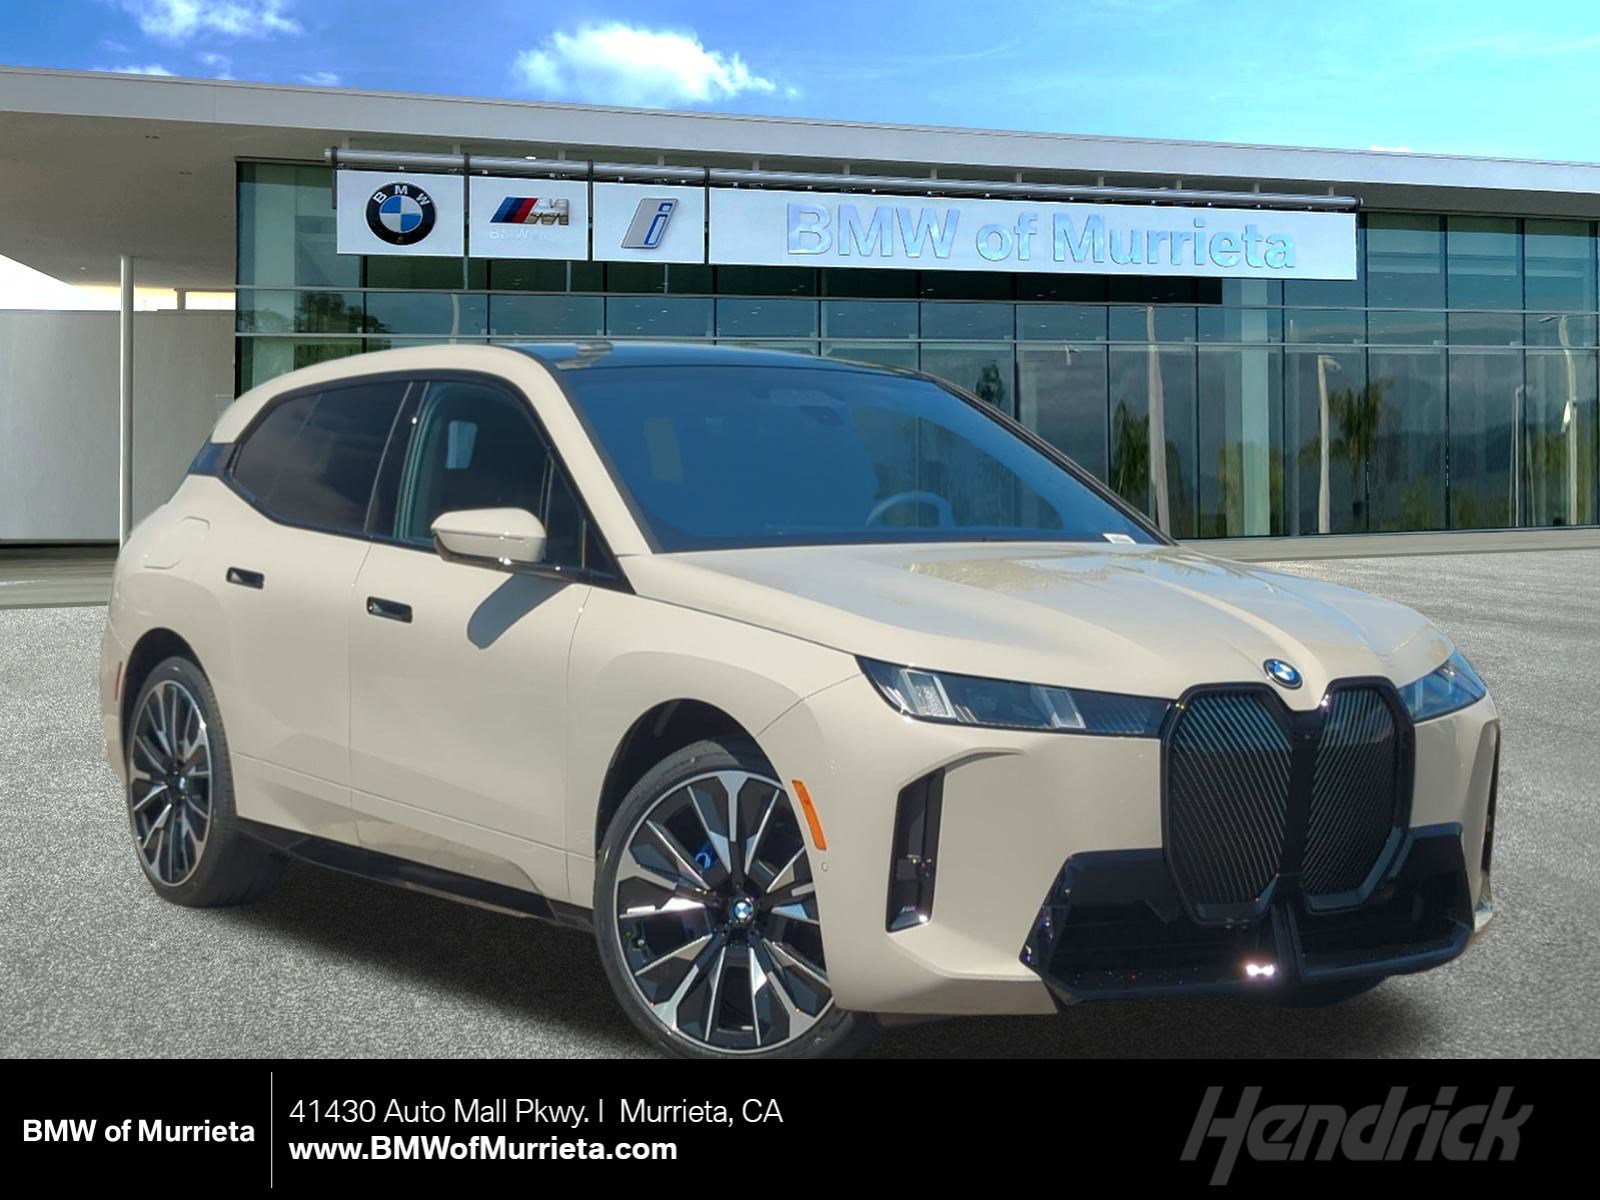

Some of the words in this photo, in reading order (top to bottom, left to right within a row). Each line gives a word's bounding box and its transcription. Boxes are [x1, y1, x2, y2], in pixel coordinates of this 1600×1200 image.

[372, 185, 430, 206] BMW
[787, 203, 960, 259] BMW
[976, 212, 1039, 262] of
[1053, 213, 1296, 269] Murrieta
